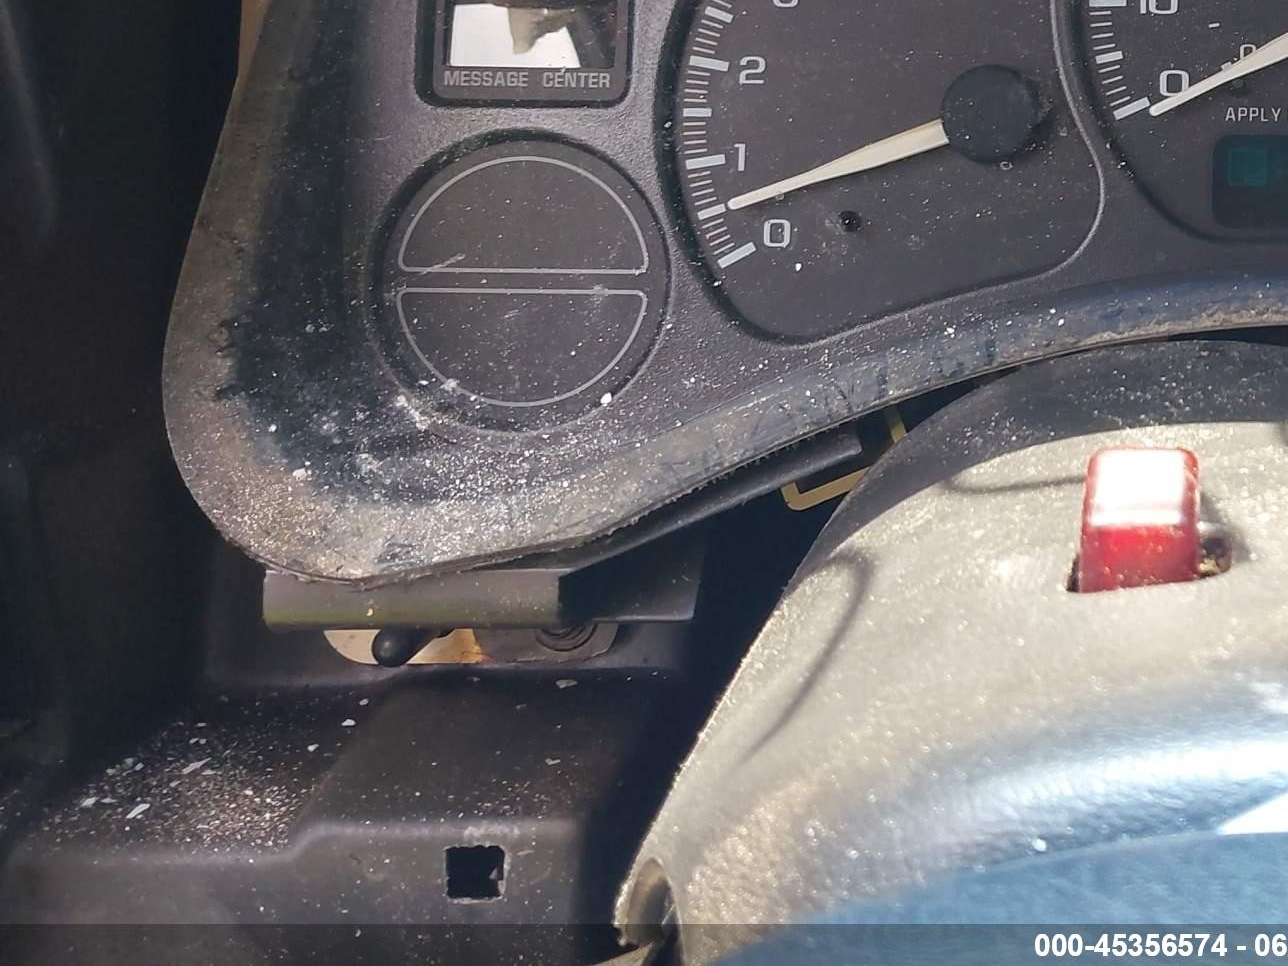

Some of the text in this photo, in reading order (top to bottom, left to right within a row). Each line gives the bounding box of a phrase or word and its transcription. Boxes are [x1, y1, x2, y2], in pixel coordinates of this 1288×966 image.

[444, 70, 611, 89] MESSAGE CENTER
[738, 57, 767, 85] 2
[1159, 69, 1190, 97] 0
[1225, 107, 1281, 123] APPLY
[733, 143, 746, 172] 1
[763, 219, 791, 248] 0
